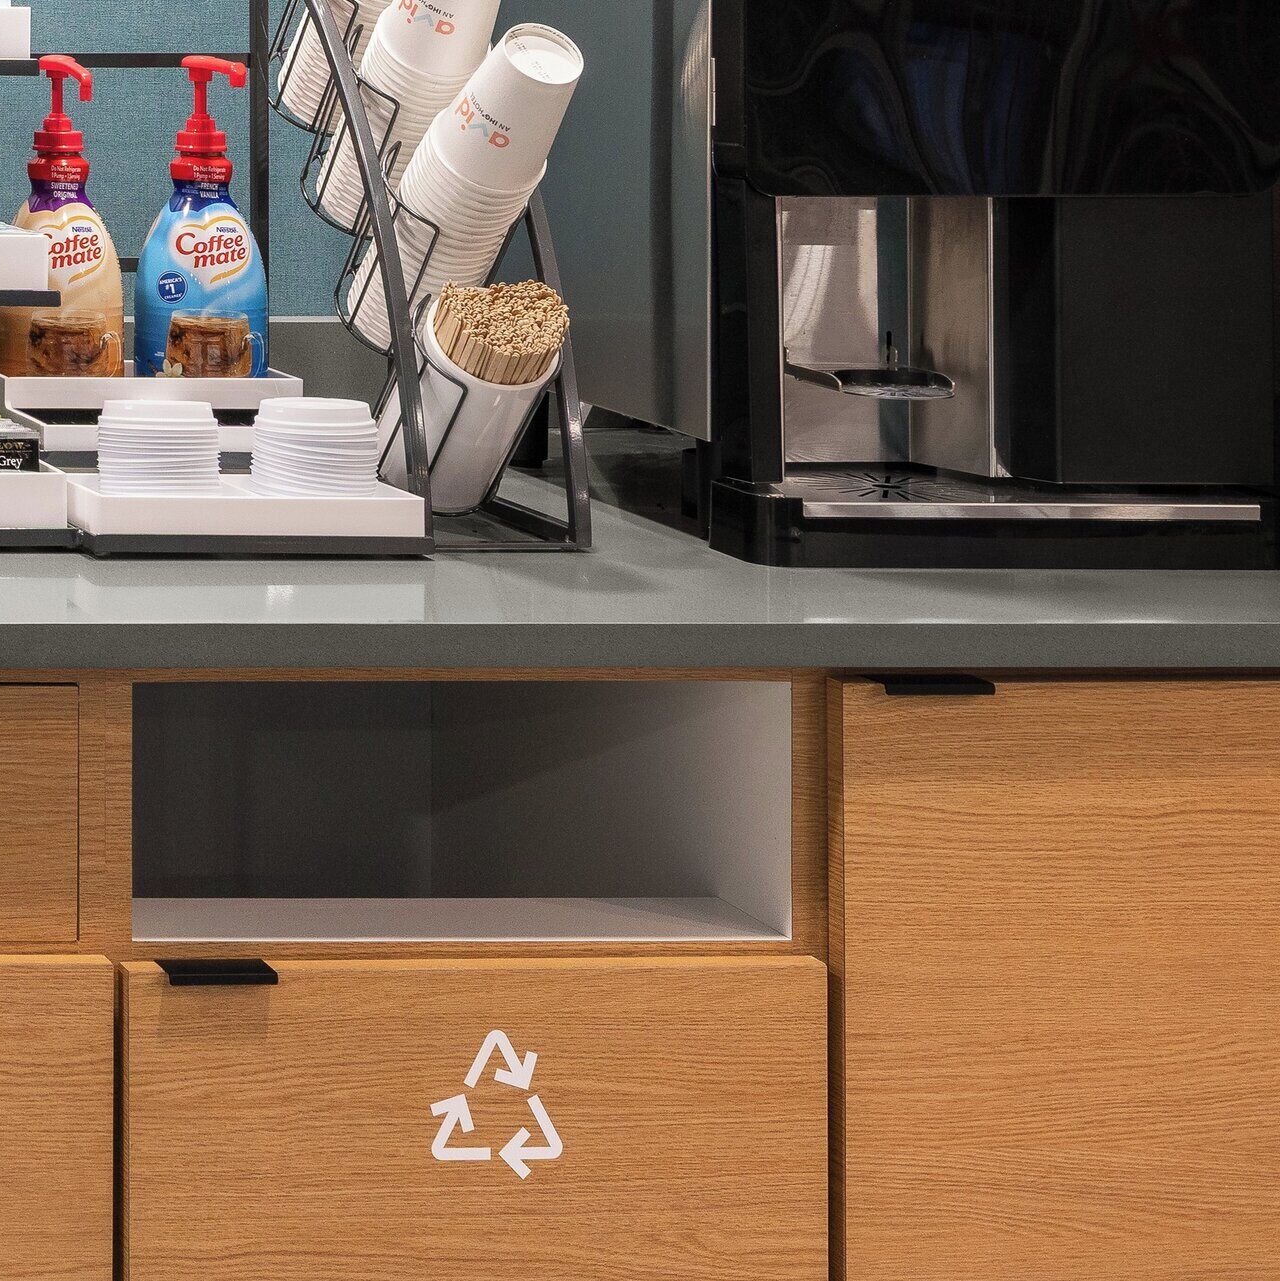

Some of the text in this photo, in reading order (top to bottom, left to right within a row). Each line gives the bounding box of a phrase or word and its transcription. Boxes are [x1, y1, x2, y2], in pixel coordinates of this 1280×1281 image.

[51, 182, 78, 190] SWEETENED
[44, 234, 99, 255] offee
[176, 235, 243, 255] Coffee
[51, 247, 101, 269] mate
[194, 247, 246, 268] mate
